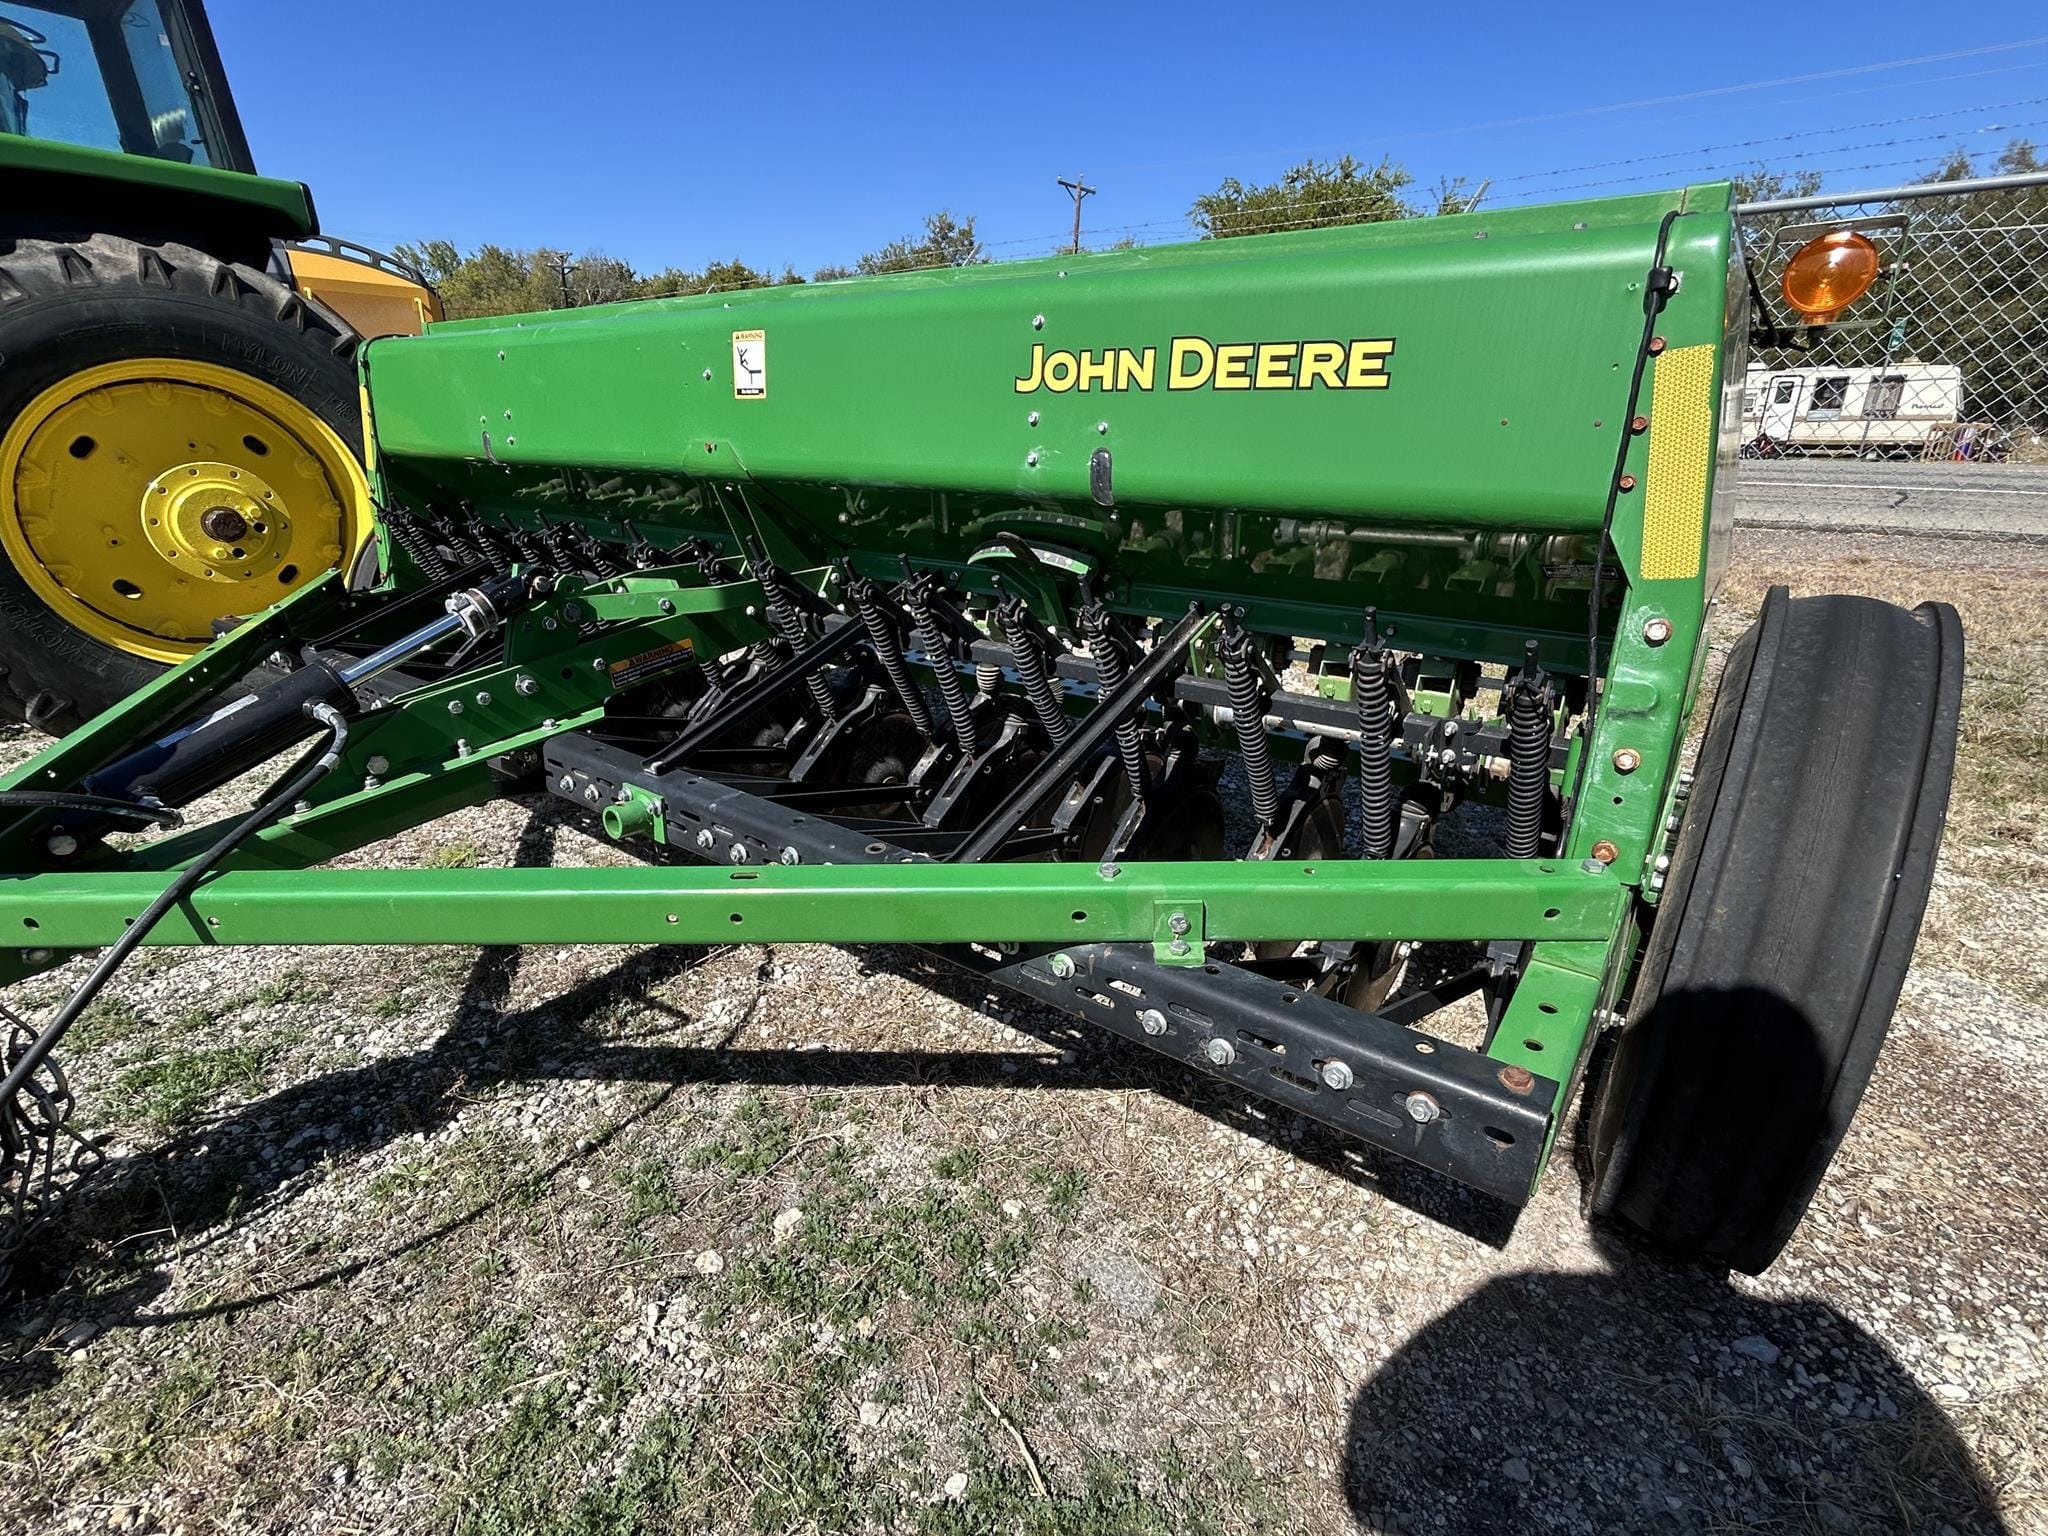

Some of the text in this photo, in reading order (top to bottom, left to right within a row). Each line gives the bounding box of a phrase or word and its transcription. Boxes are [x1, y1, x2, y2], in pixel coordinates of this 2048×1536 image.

[221, 333, 307, 384] NYLON
[1015, 336, 1397, 394] JOHN DEERE
[635, 646, 674, 664] WARNING
